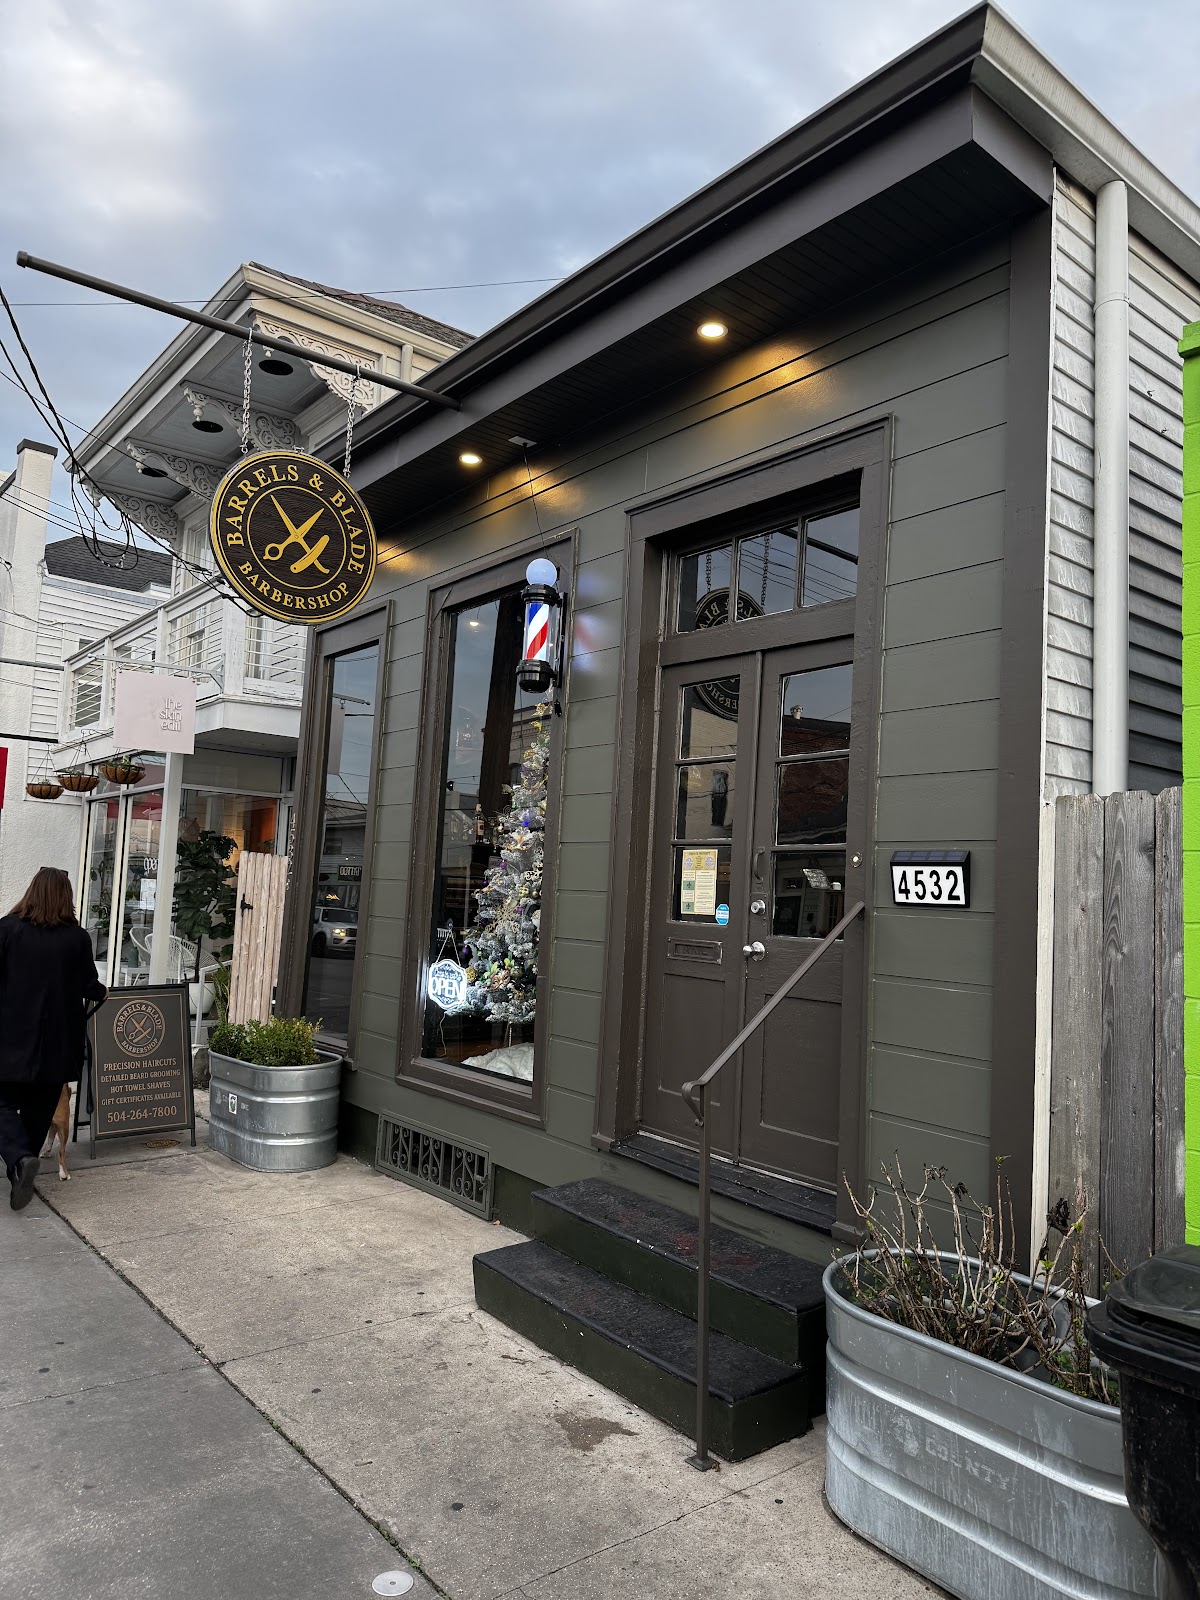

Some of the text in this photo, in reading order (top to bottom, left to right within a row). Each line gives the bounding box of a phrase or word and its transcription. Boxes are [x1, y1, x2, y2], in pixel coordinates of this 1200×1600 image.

[226, 464, 366, 575] BARRELS & BLADE
[238, 561, 350, 610] BARBERSHOP
[165, 697, 182, 710] the
[160, 709, 182, 721] skin
[161, 720, 181, 732] edit
[898, 869, 961, 901] 4532
[431, 977, 467, 1001] OPEN
[121, 1038, 158, 1054] BARBERSHOP
[103, 1058, 177, 1072] PRECISION HAIRCUTS
[100, 1069, 181, 1083] DETAILED BEARD GROOMING
[110, 1081, 171, 1094] HOT TOWEL SHAVES
[101, 1091, 182, 1106] GIFT CERTIFICATES AVAILABLE
[107, 1105, 178, 1123] 504-264-7800
